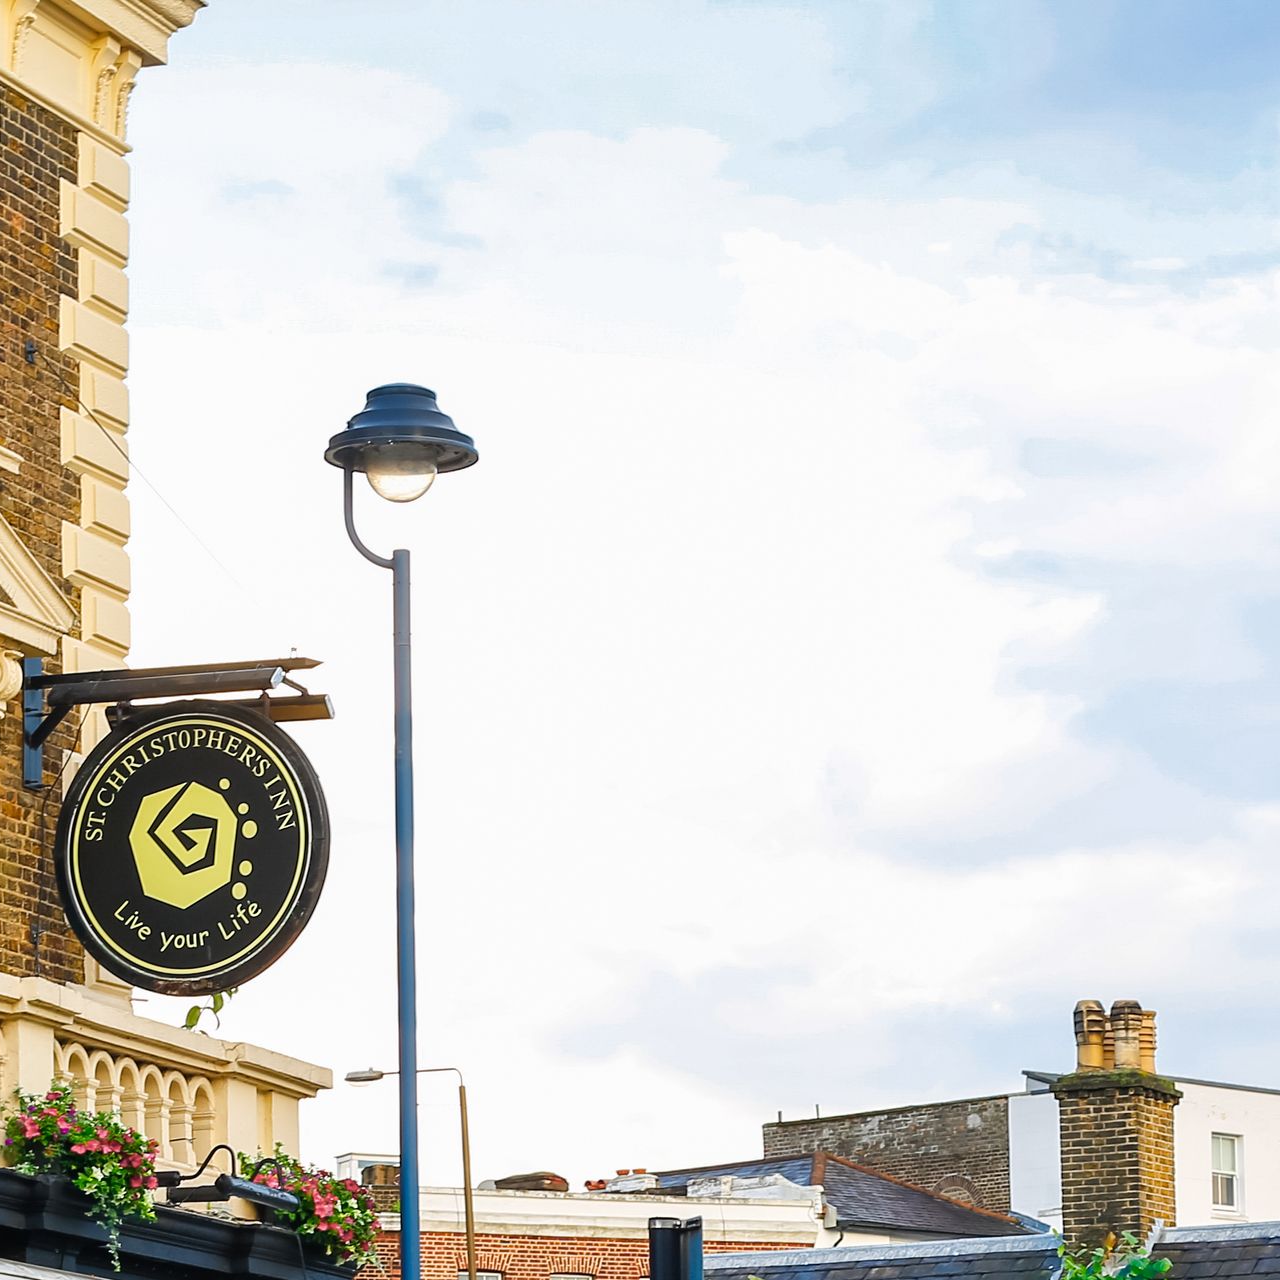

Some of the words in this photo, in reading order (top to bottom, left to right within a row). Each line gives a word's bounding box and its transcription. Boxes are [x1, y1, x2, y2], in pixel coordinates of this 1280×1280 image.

[85, 810, 108, 842] ST.
[97, 728, 271, 807] CHRISTOPHER'S
[263, 774, 296, 831] INN
[114, 900, 151, 940] Live
[160, 930, 209, 952] your
[218, 901, 262, 940] Life
